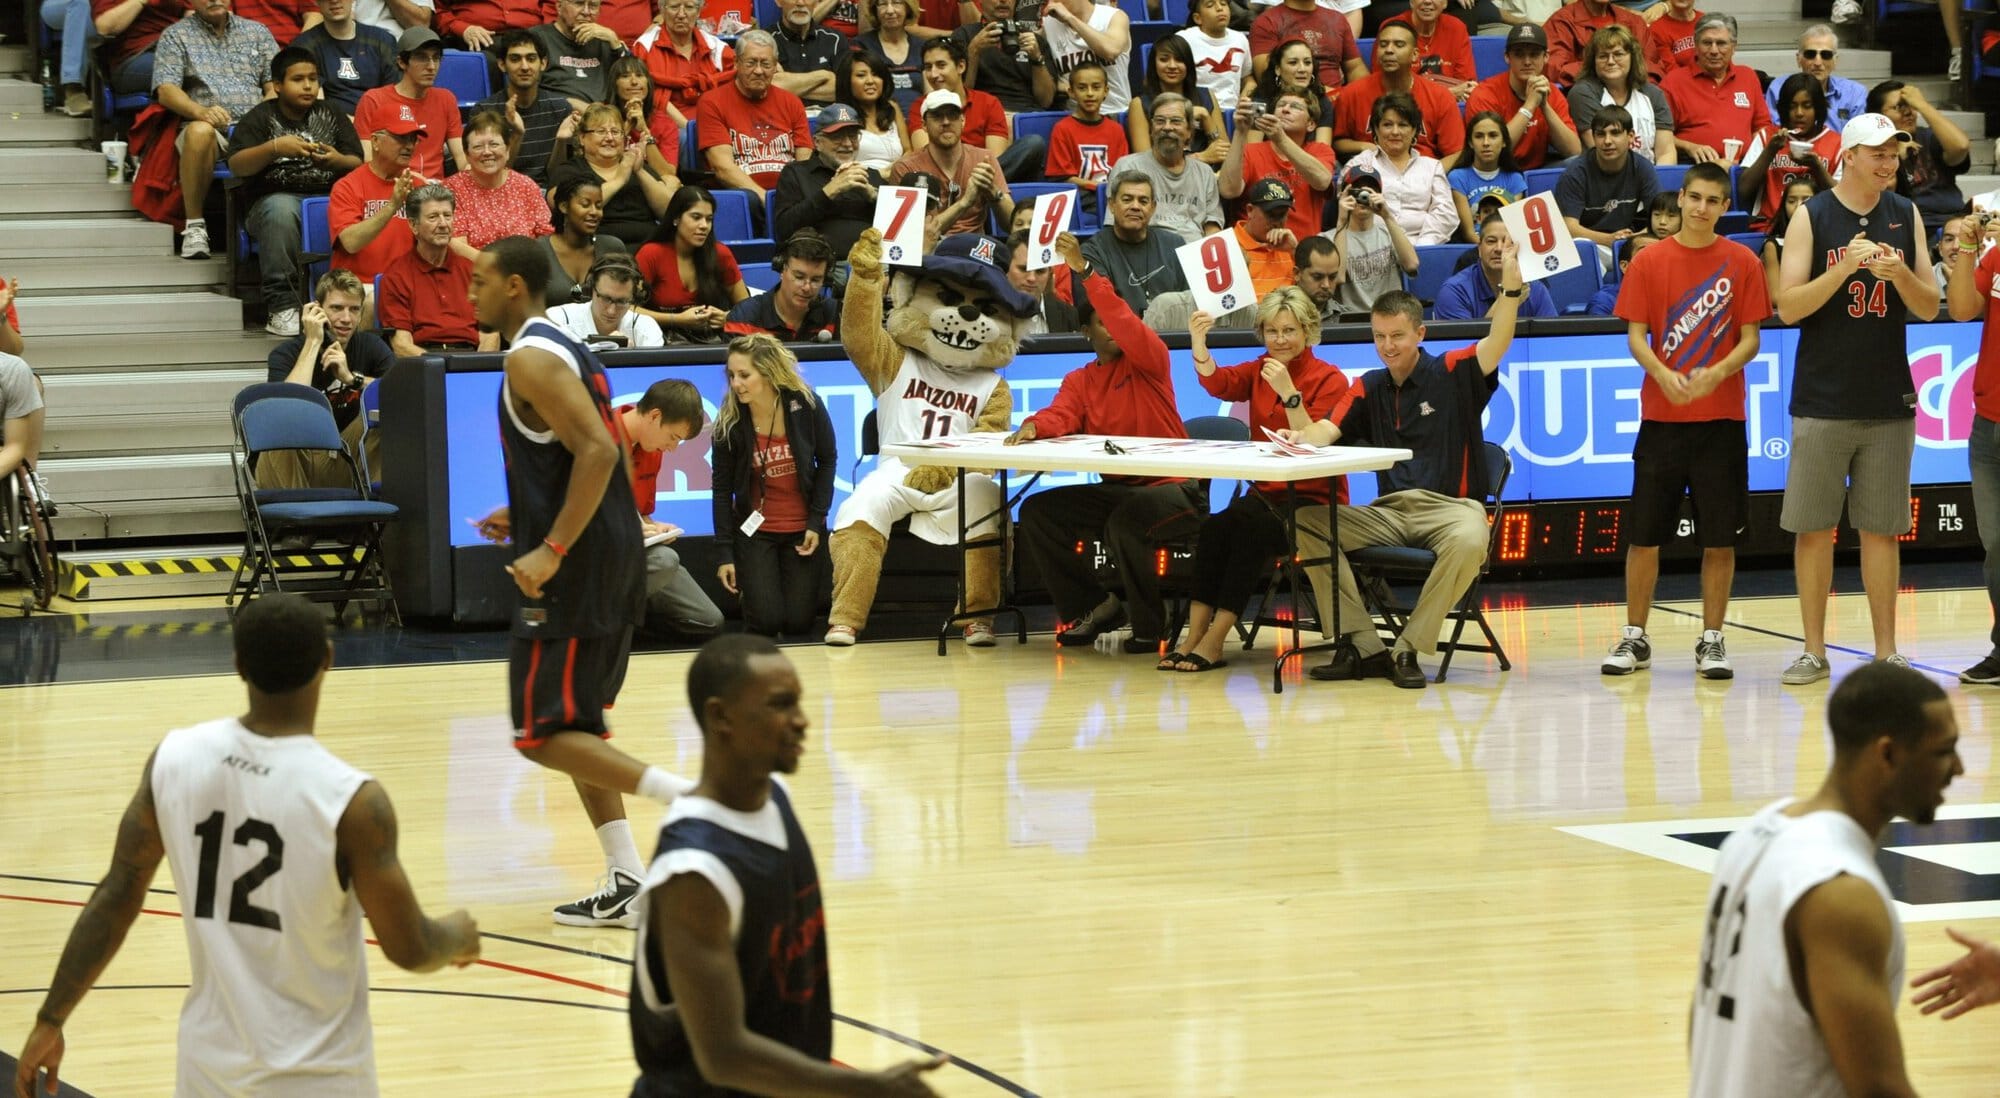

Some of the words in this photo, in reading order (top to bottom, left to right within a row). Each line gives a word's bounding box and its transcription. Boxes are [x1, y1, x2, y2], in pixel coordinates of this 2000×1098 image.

[338, 57, 361, 80] A
[883, 188, 919, 243] 7
[1038, 192, 1068, 246] 9
[1522, 196, 1558, 256] 9
[969, 237, 997, 266] A
[1200, 235, 1234, 295] 9
[1848, 280, 1887, 317] 34
[902, 378, 978, 419] ARIZONA
[921, 409, 952, 440] 11
[1938, 504, 1957, 517] TM
[1938, 518, 1964, 532] FLS
[194, 809, 285, 933] 12
